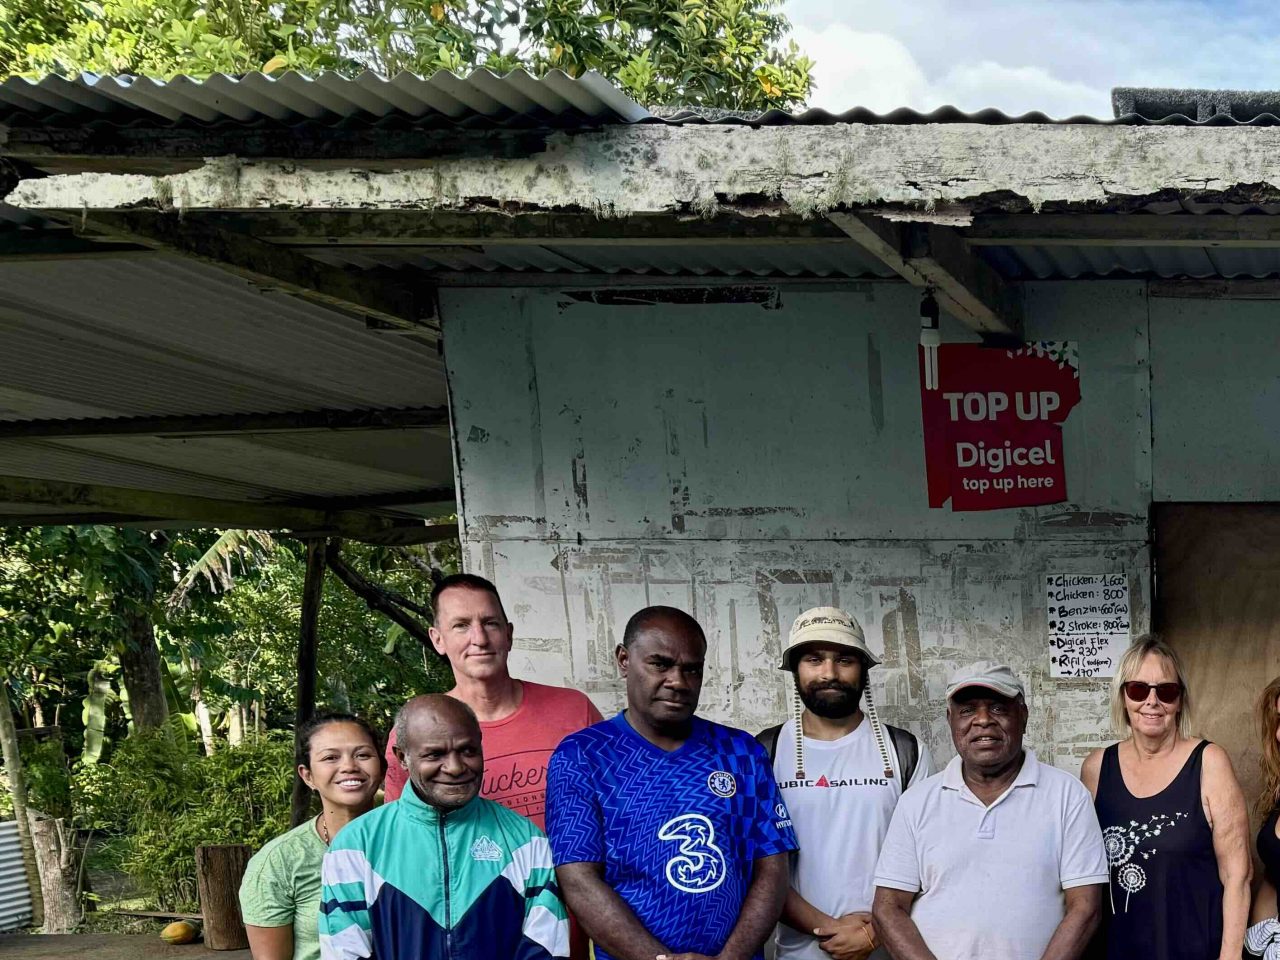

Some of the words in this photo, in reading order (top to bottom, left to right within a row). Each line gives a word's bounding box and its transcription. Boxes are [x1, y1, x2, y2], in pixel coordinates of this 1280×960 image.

[942, 392, 1009, 421] TOP
[1015, 391, 1060, 421] UP
[956, 439, 1056, 474] Digicel
[962, 477, 990, 494] top
[993, 477, 1015, 493] up
[1017, 474, 1054, 490] here
[1057, 620, 1066, 632] 2
[1056, 637, 1087, 649] Digicel
[1090, 637, 1109, 648] Flex
[1058, 654, 1081, 668] Rifil
[482, 762, 548, 796] ucker
[776, 779, 815, 790] UBIC
[829, 778, 889, 788] SAILING
